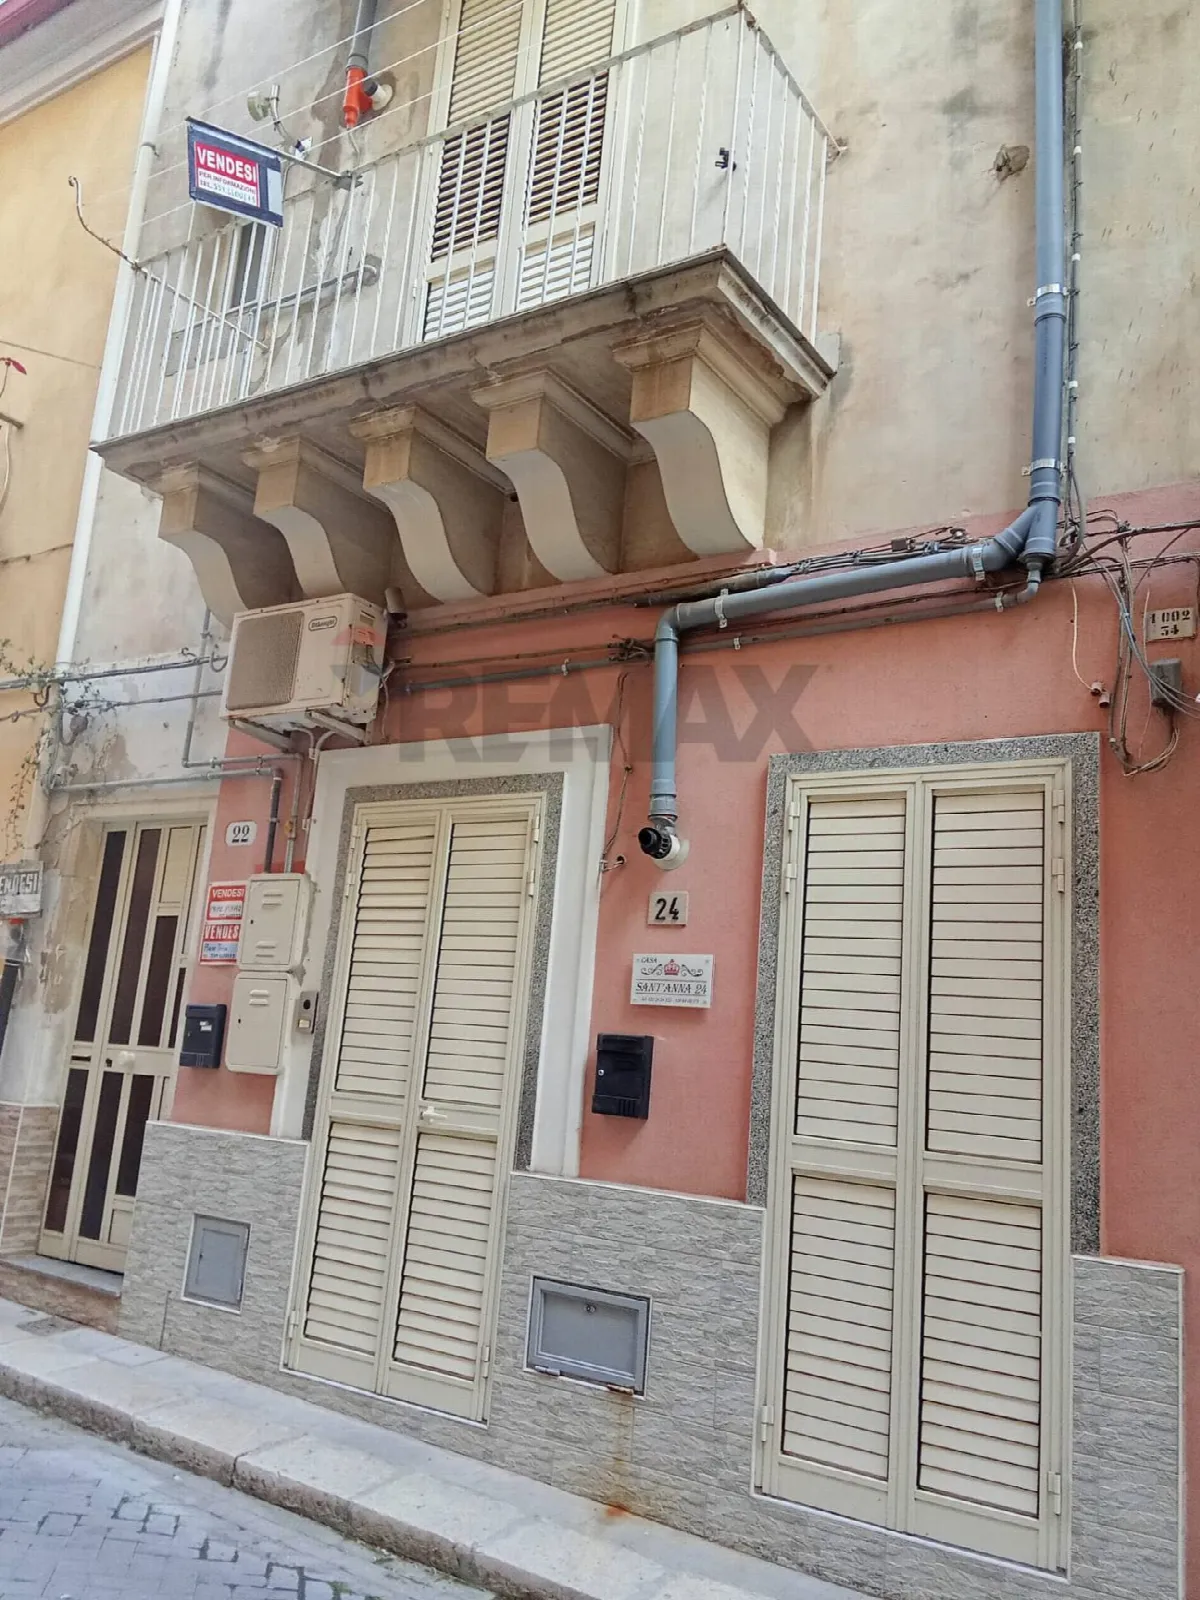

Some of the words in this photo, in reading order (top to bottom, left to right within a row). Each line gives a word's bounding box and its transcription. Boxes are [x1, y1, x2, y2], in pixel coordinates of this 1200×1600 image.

[197, 146, 256, 183] VENDESI
[231, 825, 250, 843] 22
[212, 888, 245, 899] VENDESI
[655, 897, 680, 920] 24
[204, 925, 240, 940] VENDES
[636, 982, 691, 994] SANT'ANNA
[694, 984, 708, 995] 24
